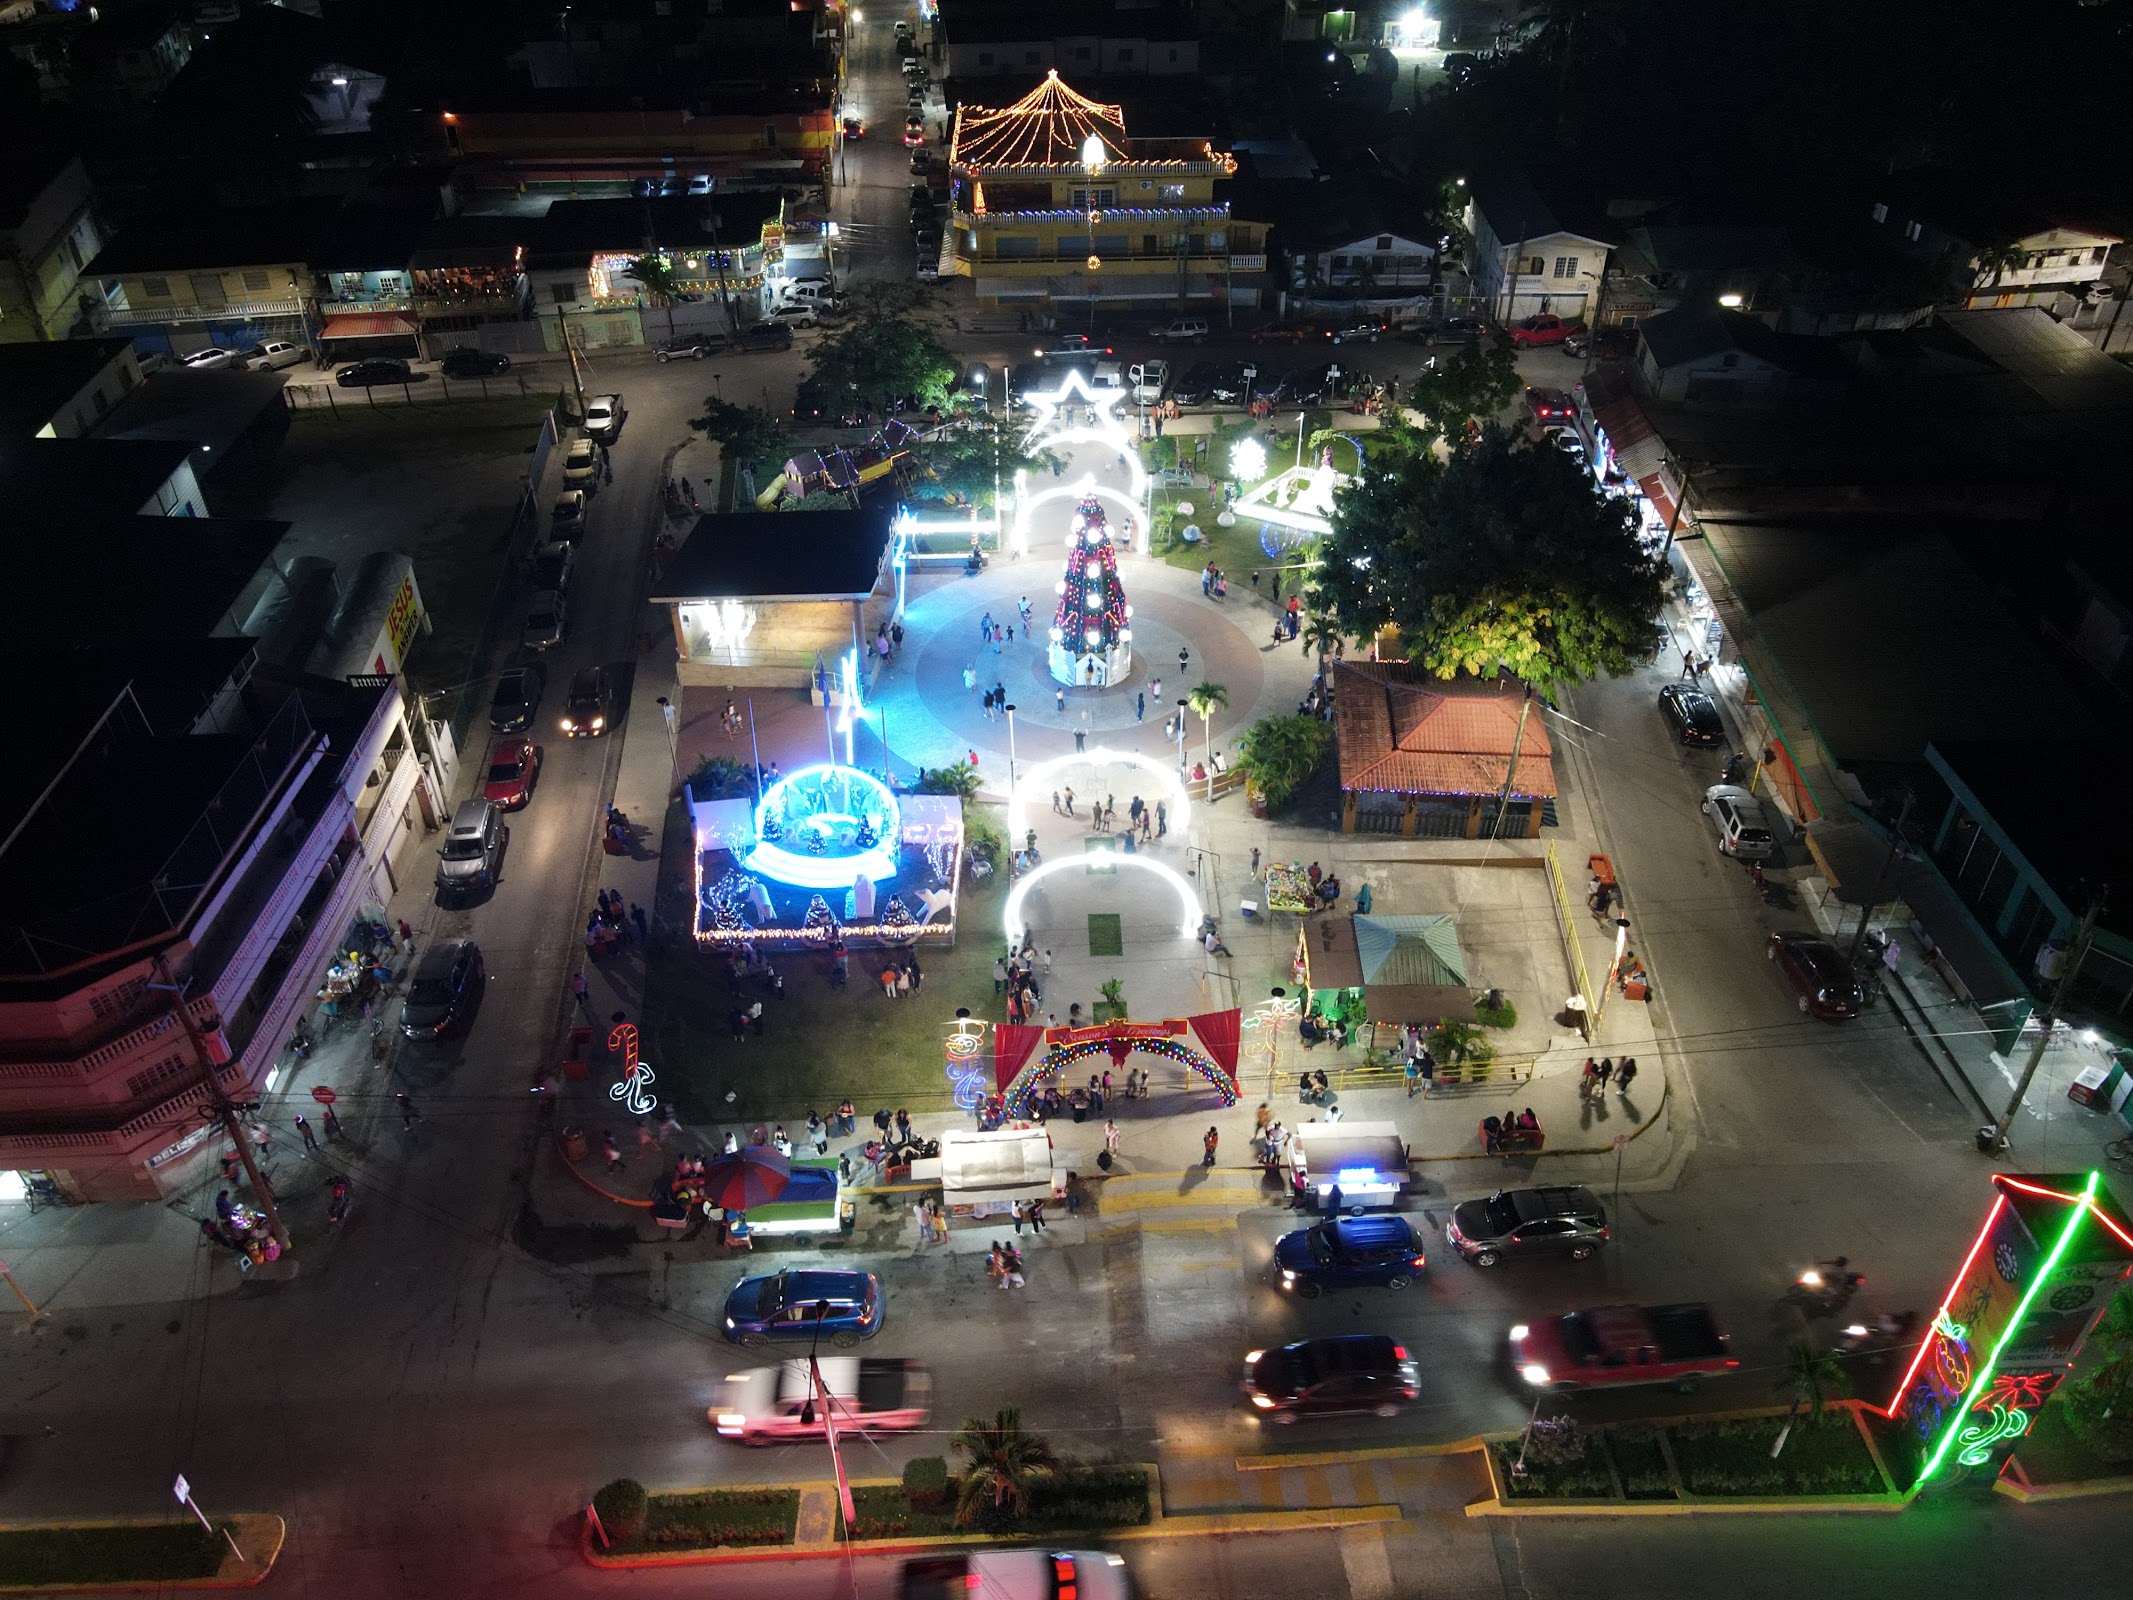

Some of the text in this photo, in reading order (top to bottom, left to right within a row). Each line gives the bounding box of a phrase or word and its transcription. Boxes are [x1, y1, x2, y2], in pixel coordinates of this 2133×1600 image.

[388, 575, 413, 641] JESUS
[398, 609, 418, 660] ANSWER
[1063, 1026, 1171, 1044] Season's Greetings
